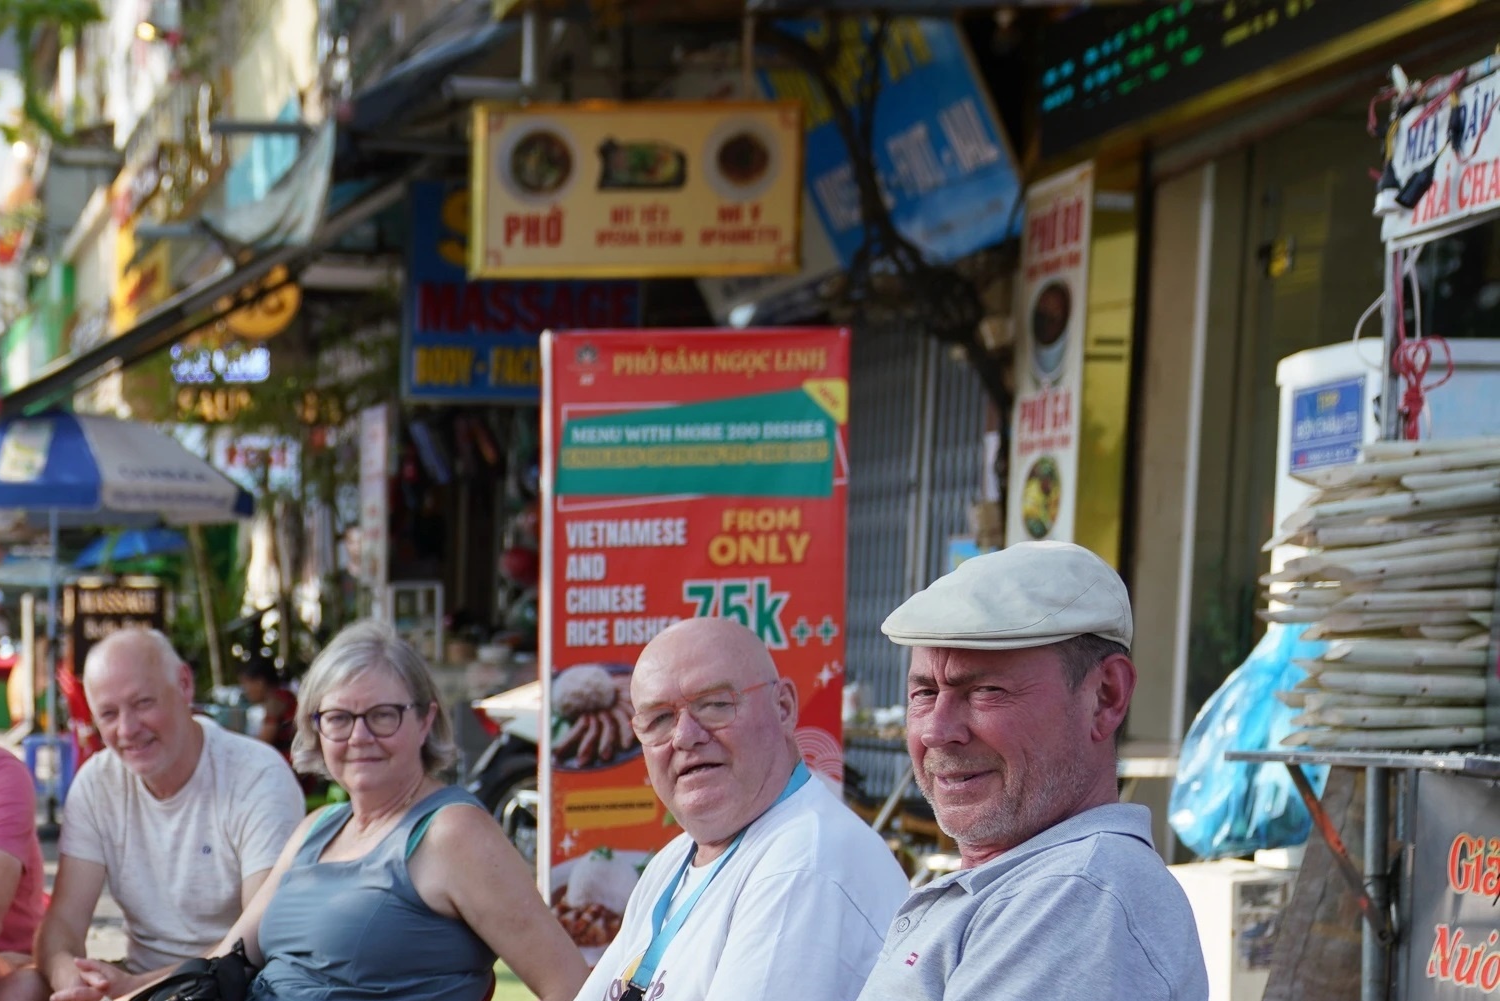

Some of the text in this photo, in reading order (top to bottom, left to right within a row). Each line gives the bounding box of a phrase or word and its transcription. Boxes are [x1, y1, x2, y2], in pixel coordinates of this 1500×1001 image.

[504, 205, 564, 247] PHỞ
[625, 424, 672, 443] WITH
[565, 517, 688, 549] VIETNAMESE
[722, 507, 800, 532] FROM
[708, 531, 811, 566] ONLY
[565, 552, 607, 581] AND
[565, 584, 646, 614] CHINESE
[565, 618, 609, 647] RICE
